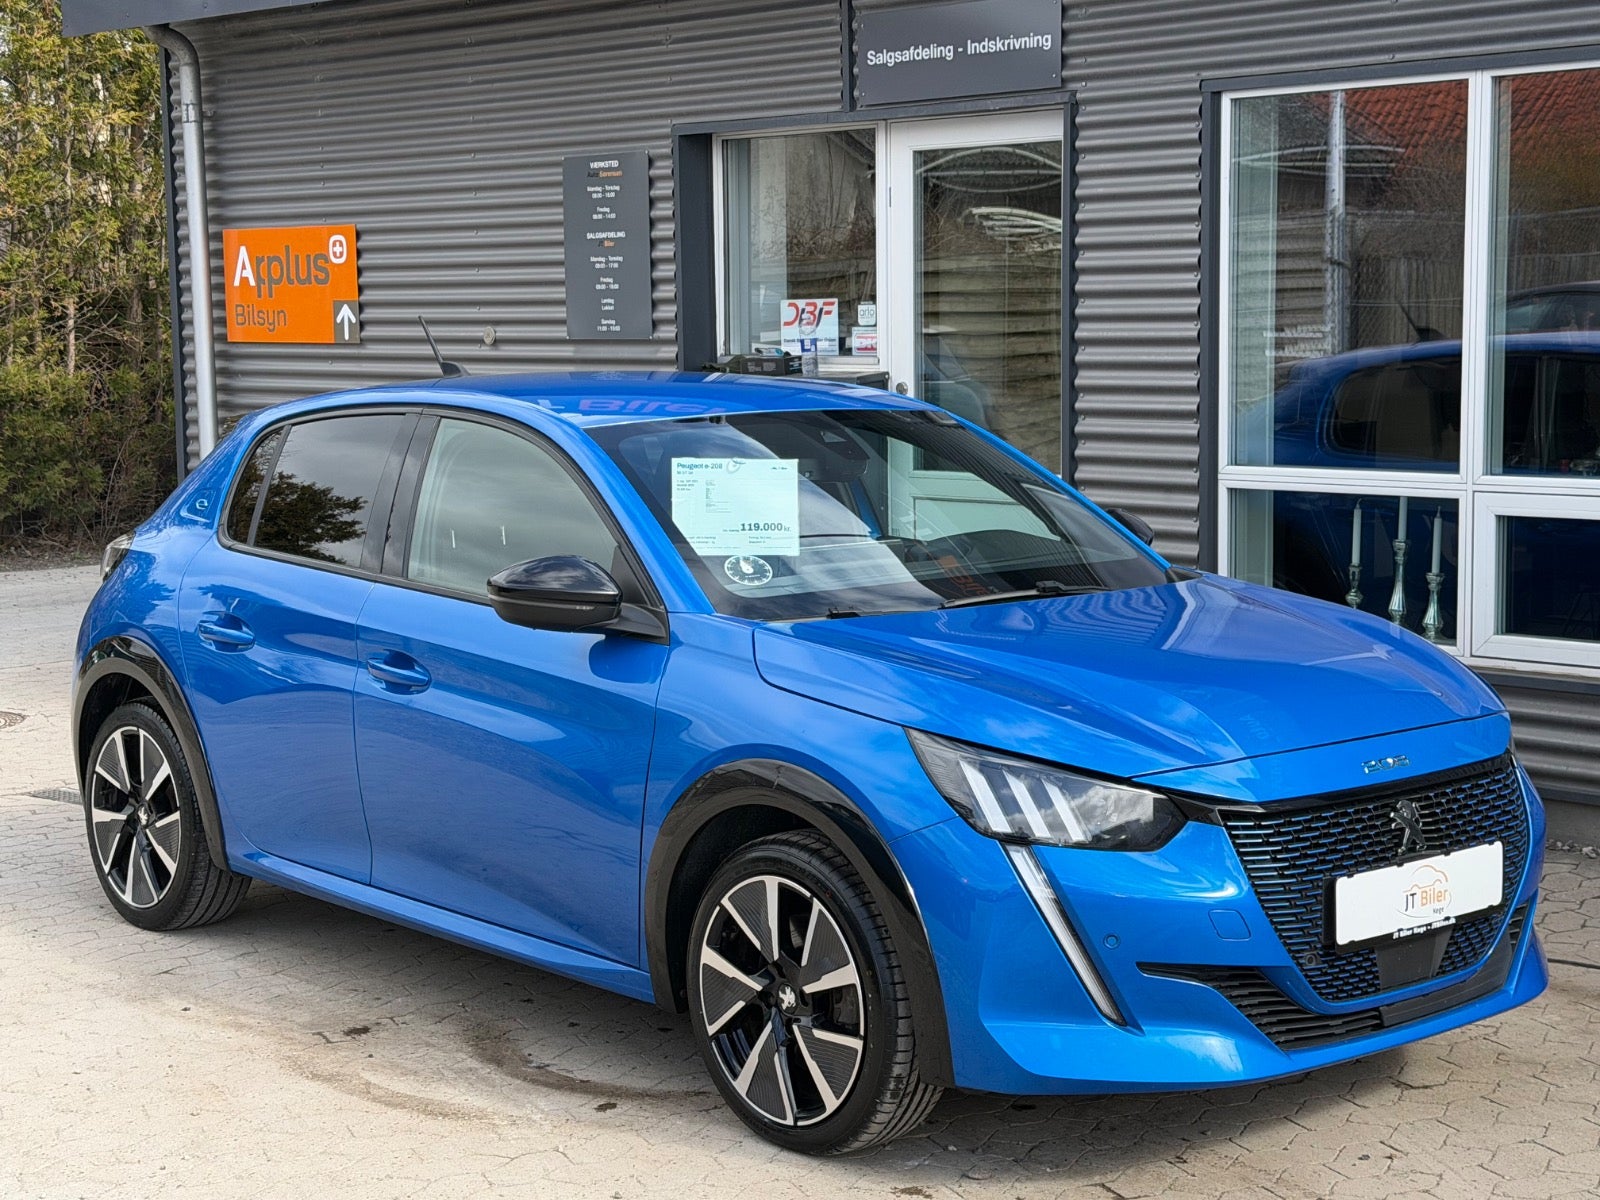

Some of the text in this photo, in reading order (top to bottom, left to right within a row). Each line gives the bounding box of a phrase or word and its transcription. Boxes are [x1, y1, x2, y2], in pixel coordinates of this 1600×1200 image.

[866, 44, 954, 67] Salgsafdeling
[967, 32, 1052, 55] Indskrivning
[590, 160, 619, 169] VÆRKSTED
[586, 231, 626, 239] SALGSAFDELING
[235, 303, 287, 333] Bilsyn
[676, 462, 703, 471] Peugeot
[740, 522, 783, 532] 119.000
[1404, 888, 1448, 912] JT Biler
